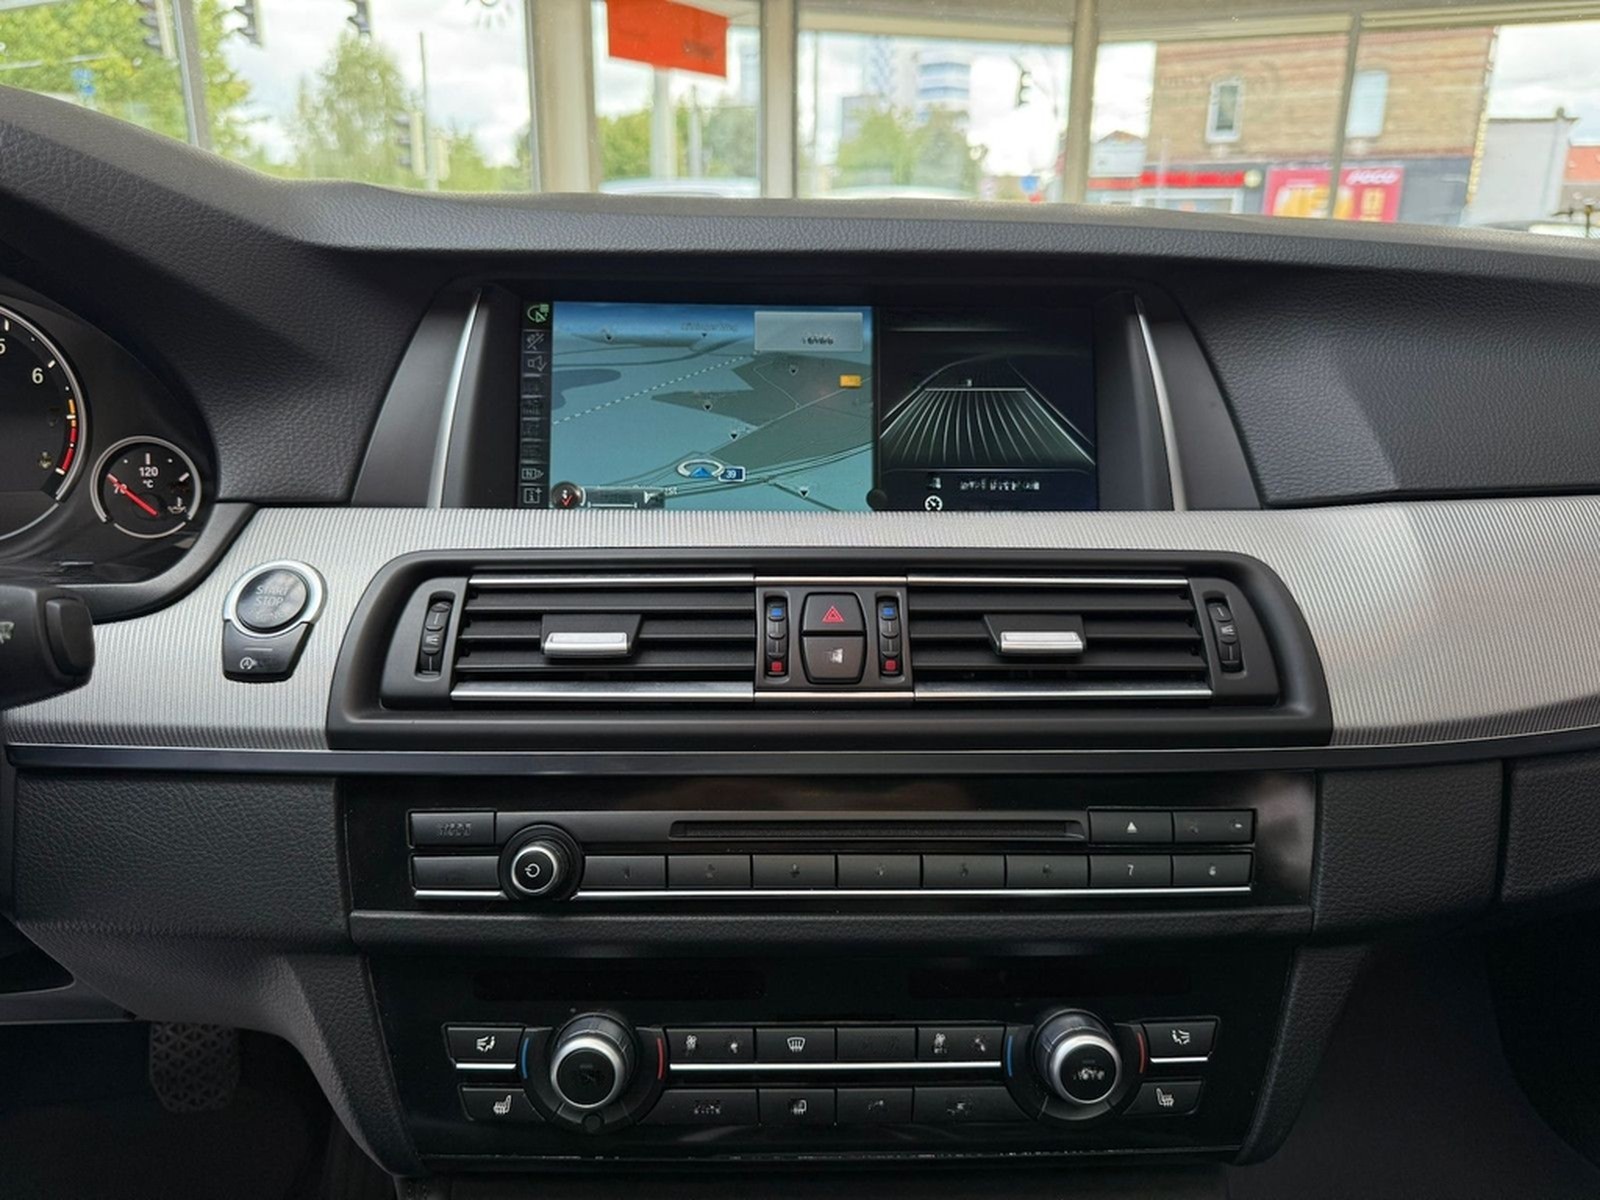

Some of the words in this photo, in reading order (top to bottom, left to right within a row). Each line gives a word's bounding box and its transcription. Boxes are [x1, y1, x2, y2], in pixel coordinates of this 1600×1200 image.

[32, 367, 44, 384] 6
[138, 466, 159, 477] 120
[255, 585, 288, 596] START
[255, 596, 284, 607] STOP
[1127, 863, 1135, 876] 7
